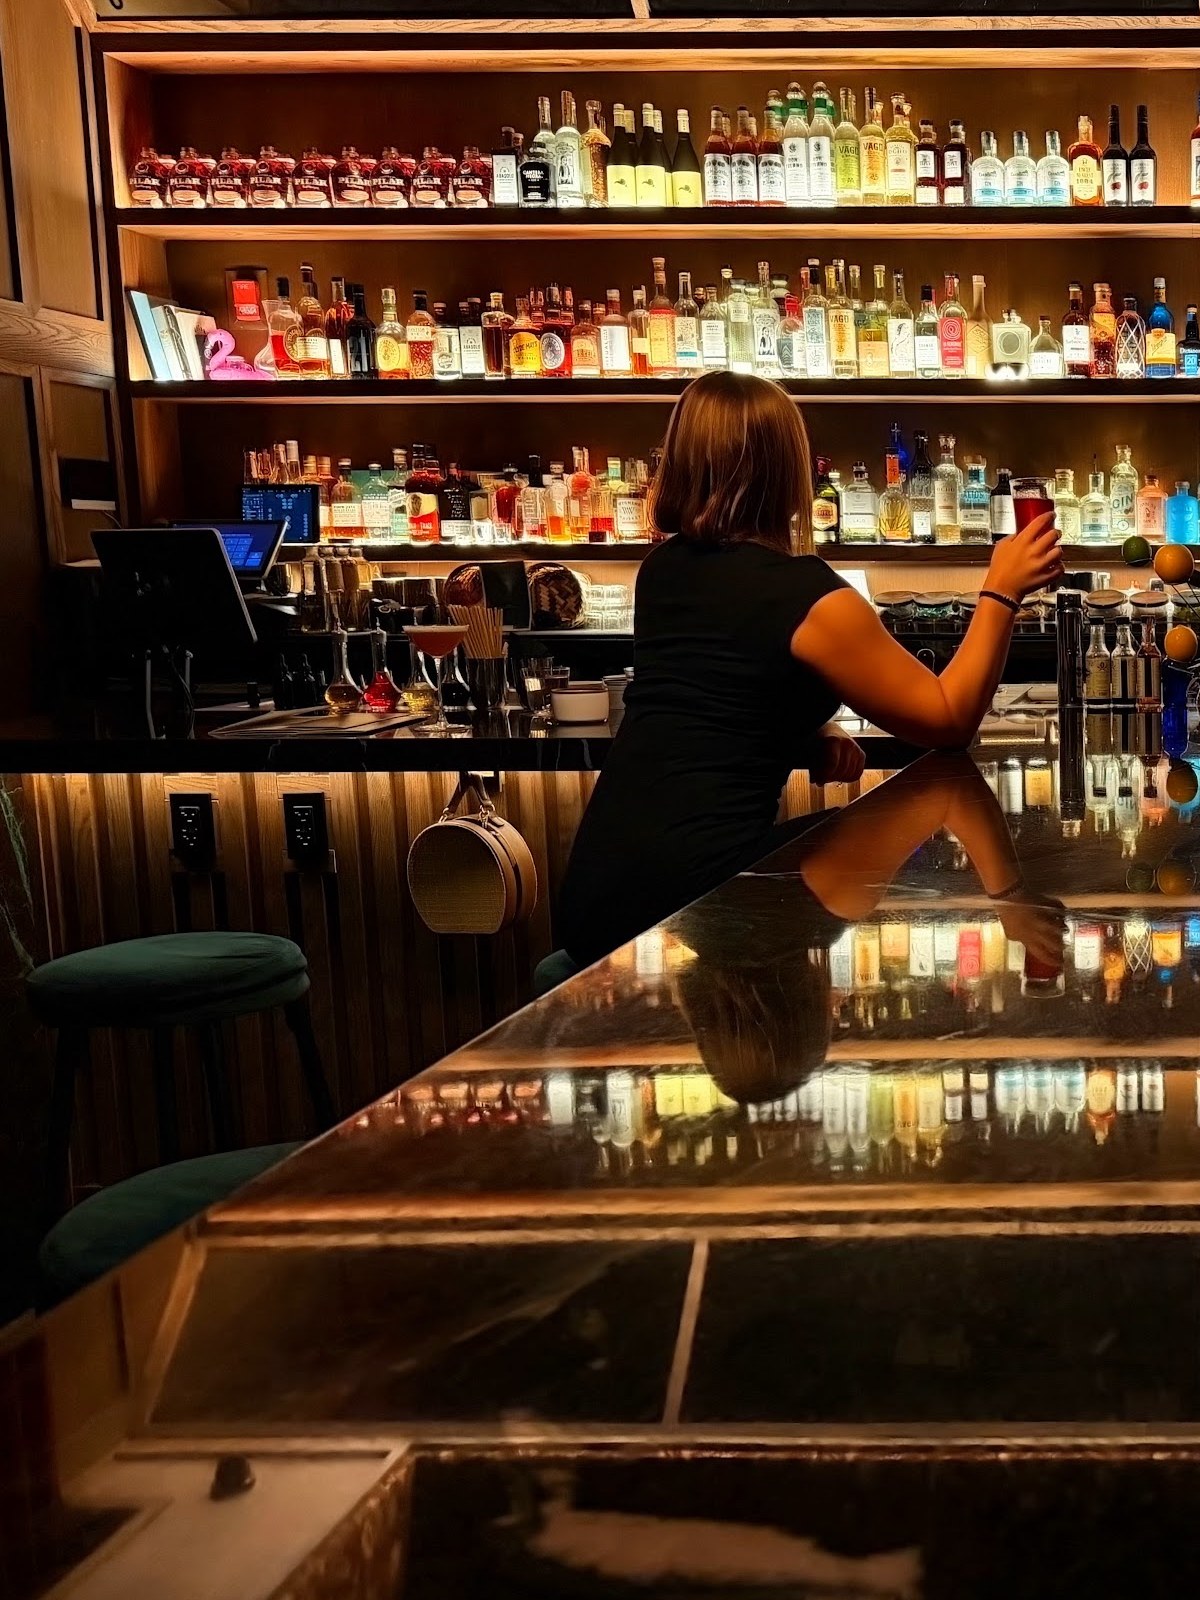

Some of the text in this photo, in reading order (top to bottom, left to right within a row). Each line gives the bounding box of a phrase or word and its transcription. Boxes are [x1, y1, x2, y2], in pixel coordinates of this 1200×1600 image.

[838, 145, 860, 155] VAGO
[863, 142, 884, 151] VAGO
[129, 177, 161, 187] PILAR
[169, 177, 202, 186] PILAR
[211, 177, 243, 186] PILAR
[249, 176, 282, 185] PILAR
[294, 178, 328, 187] PILAR
[338, 177, 371, 187] PILAR
[371, 177, 405, 187] PILAR
[412, 177, 443, 186] PILAR
[453, 177, 484, 186] PILAR
[830, 315, 850, 323] VAGO
[1186, 355, 1197, 365] 20
[1112, 495, 1134, 510] GIN
